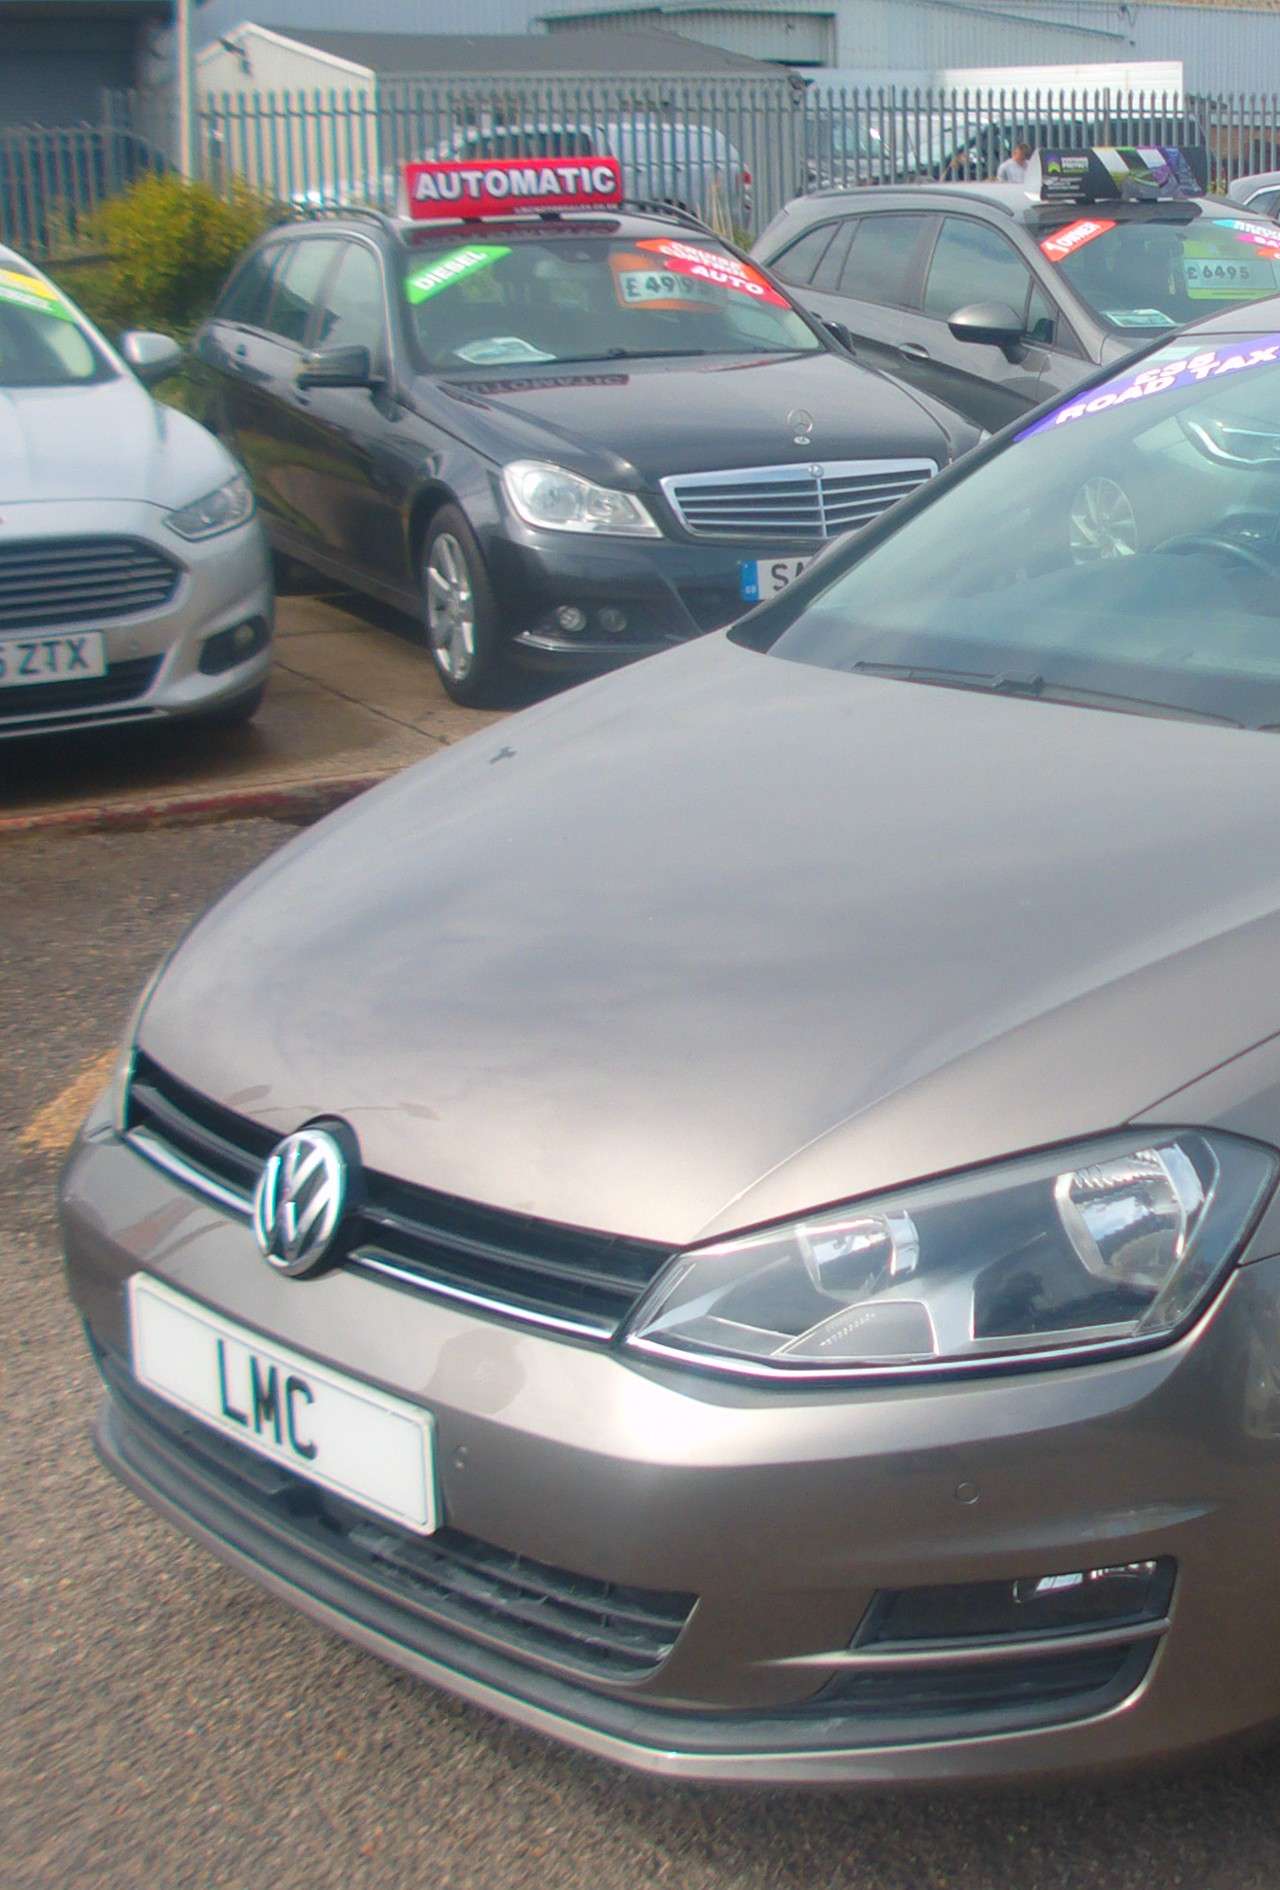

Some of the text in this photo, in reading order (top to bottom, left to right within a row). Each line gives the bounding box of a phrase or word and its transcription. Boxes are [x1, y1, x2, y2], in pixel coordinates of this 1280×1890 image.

[415, 165, 616, 201] AUTOMATIC
[414, 250, 488, 291] DIESEL
[690, 265, 765, 295] AUTO
[1056, 346, 1280, 424] ROAD TAX
[16, 636, 89, 676] ZTX
[216, 1338, 318, 1460] LMC
